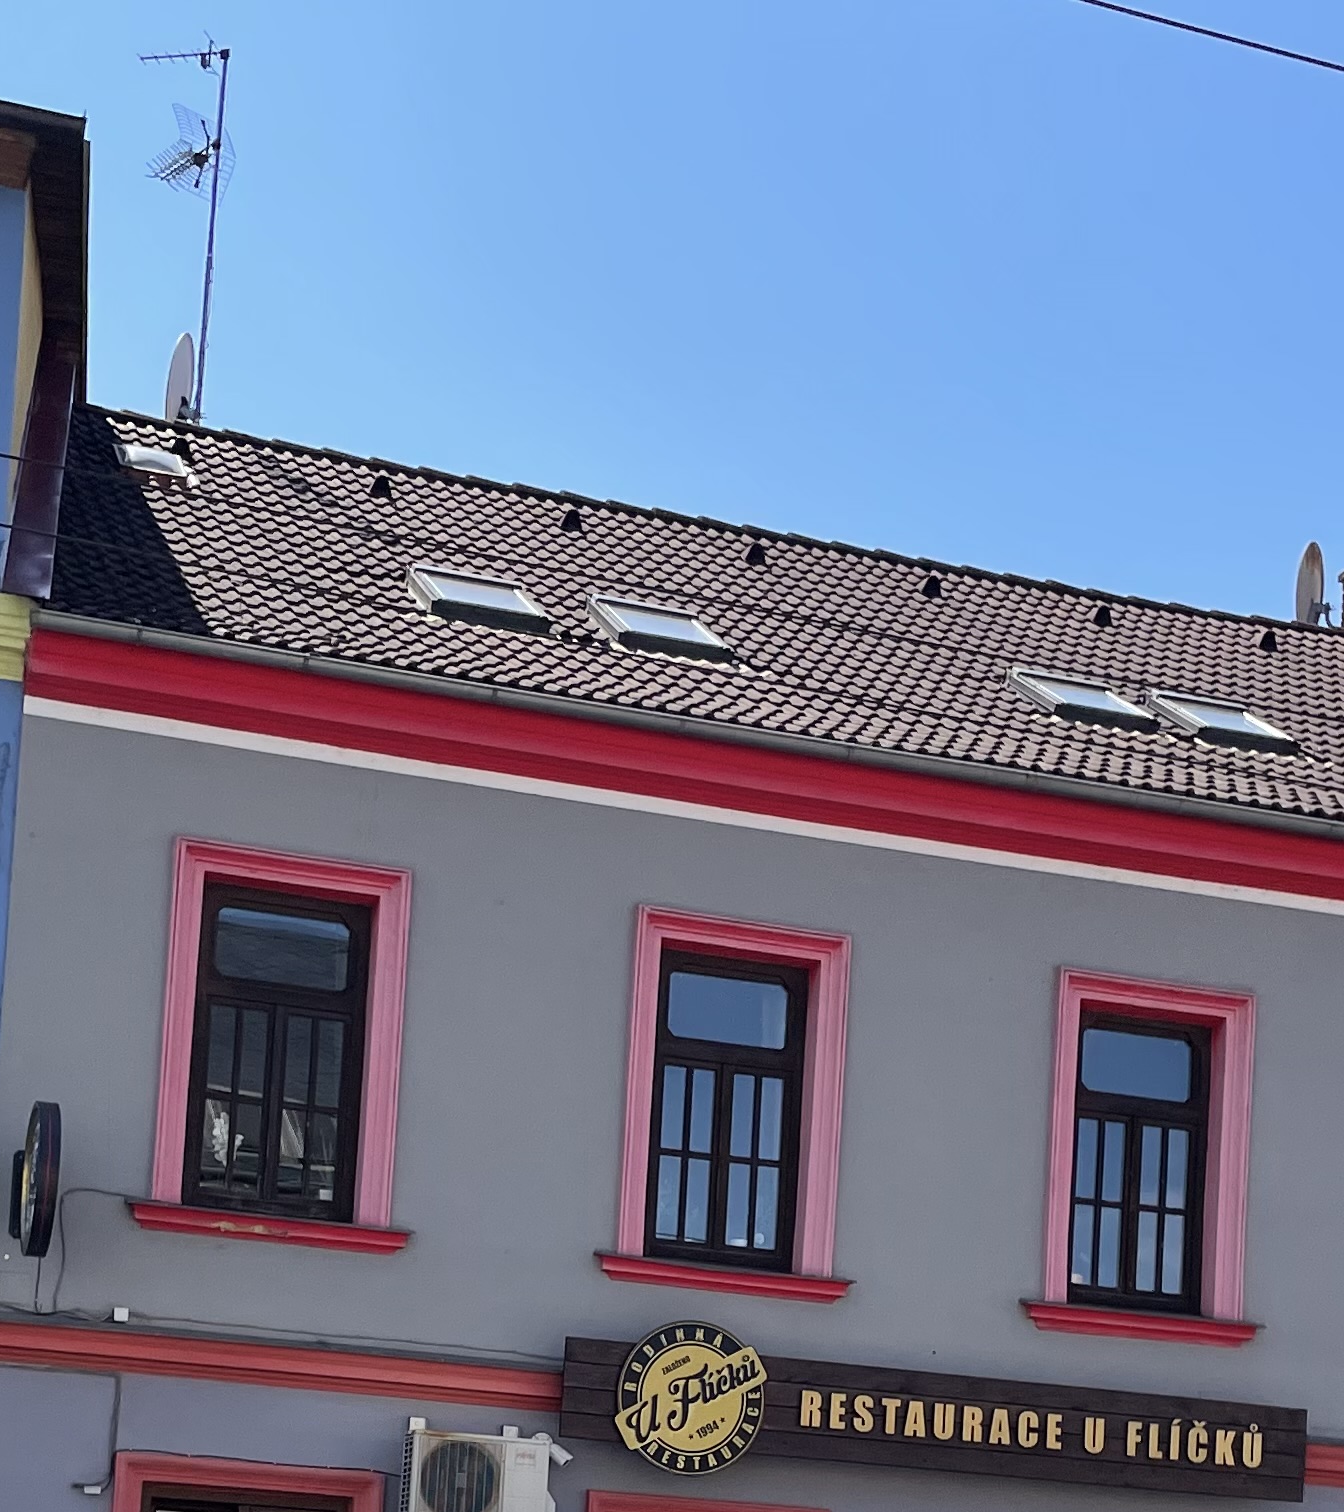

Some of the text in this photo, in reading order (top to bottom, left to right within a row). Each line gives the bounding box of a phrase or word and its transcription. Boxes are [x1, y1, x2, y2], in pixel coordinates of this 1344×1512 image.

[623, 1327, 725, 1392] RODINNÁ
[625, 1354, 761, 1443] U Flíčků
[646, 1390, 761, 1470] RESTAURACE
[695, 1420, 720, 1440] 1994
[799, 1389, 1264, 1469] RESTAURACE U FLÍČKŮ
